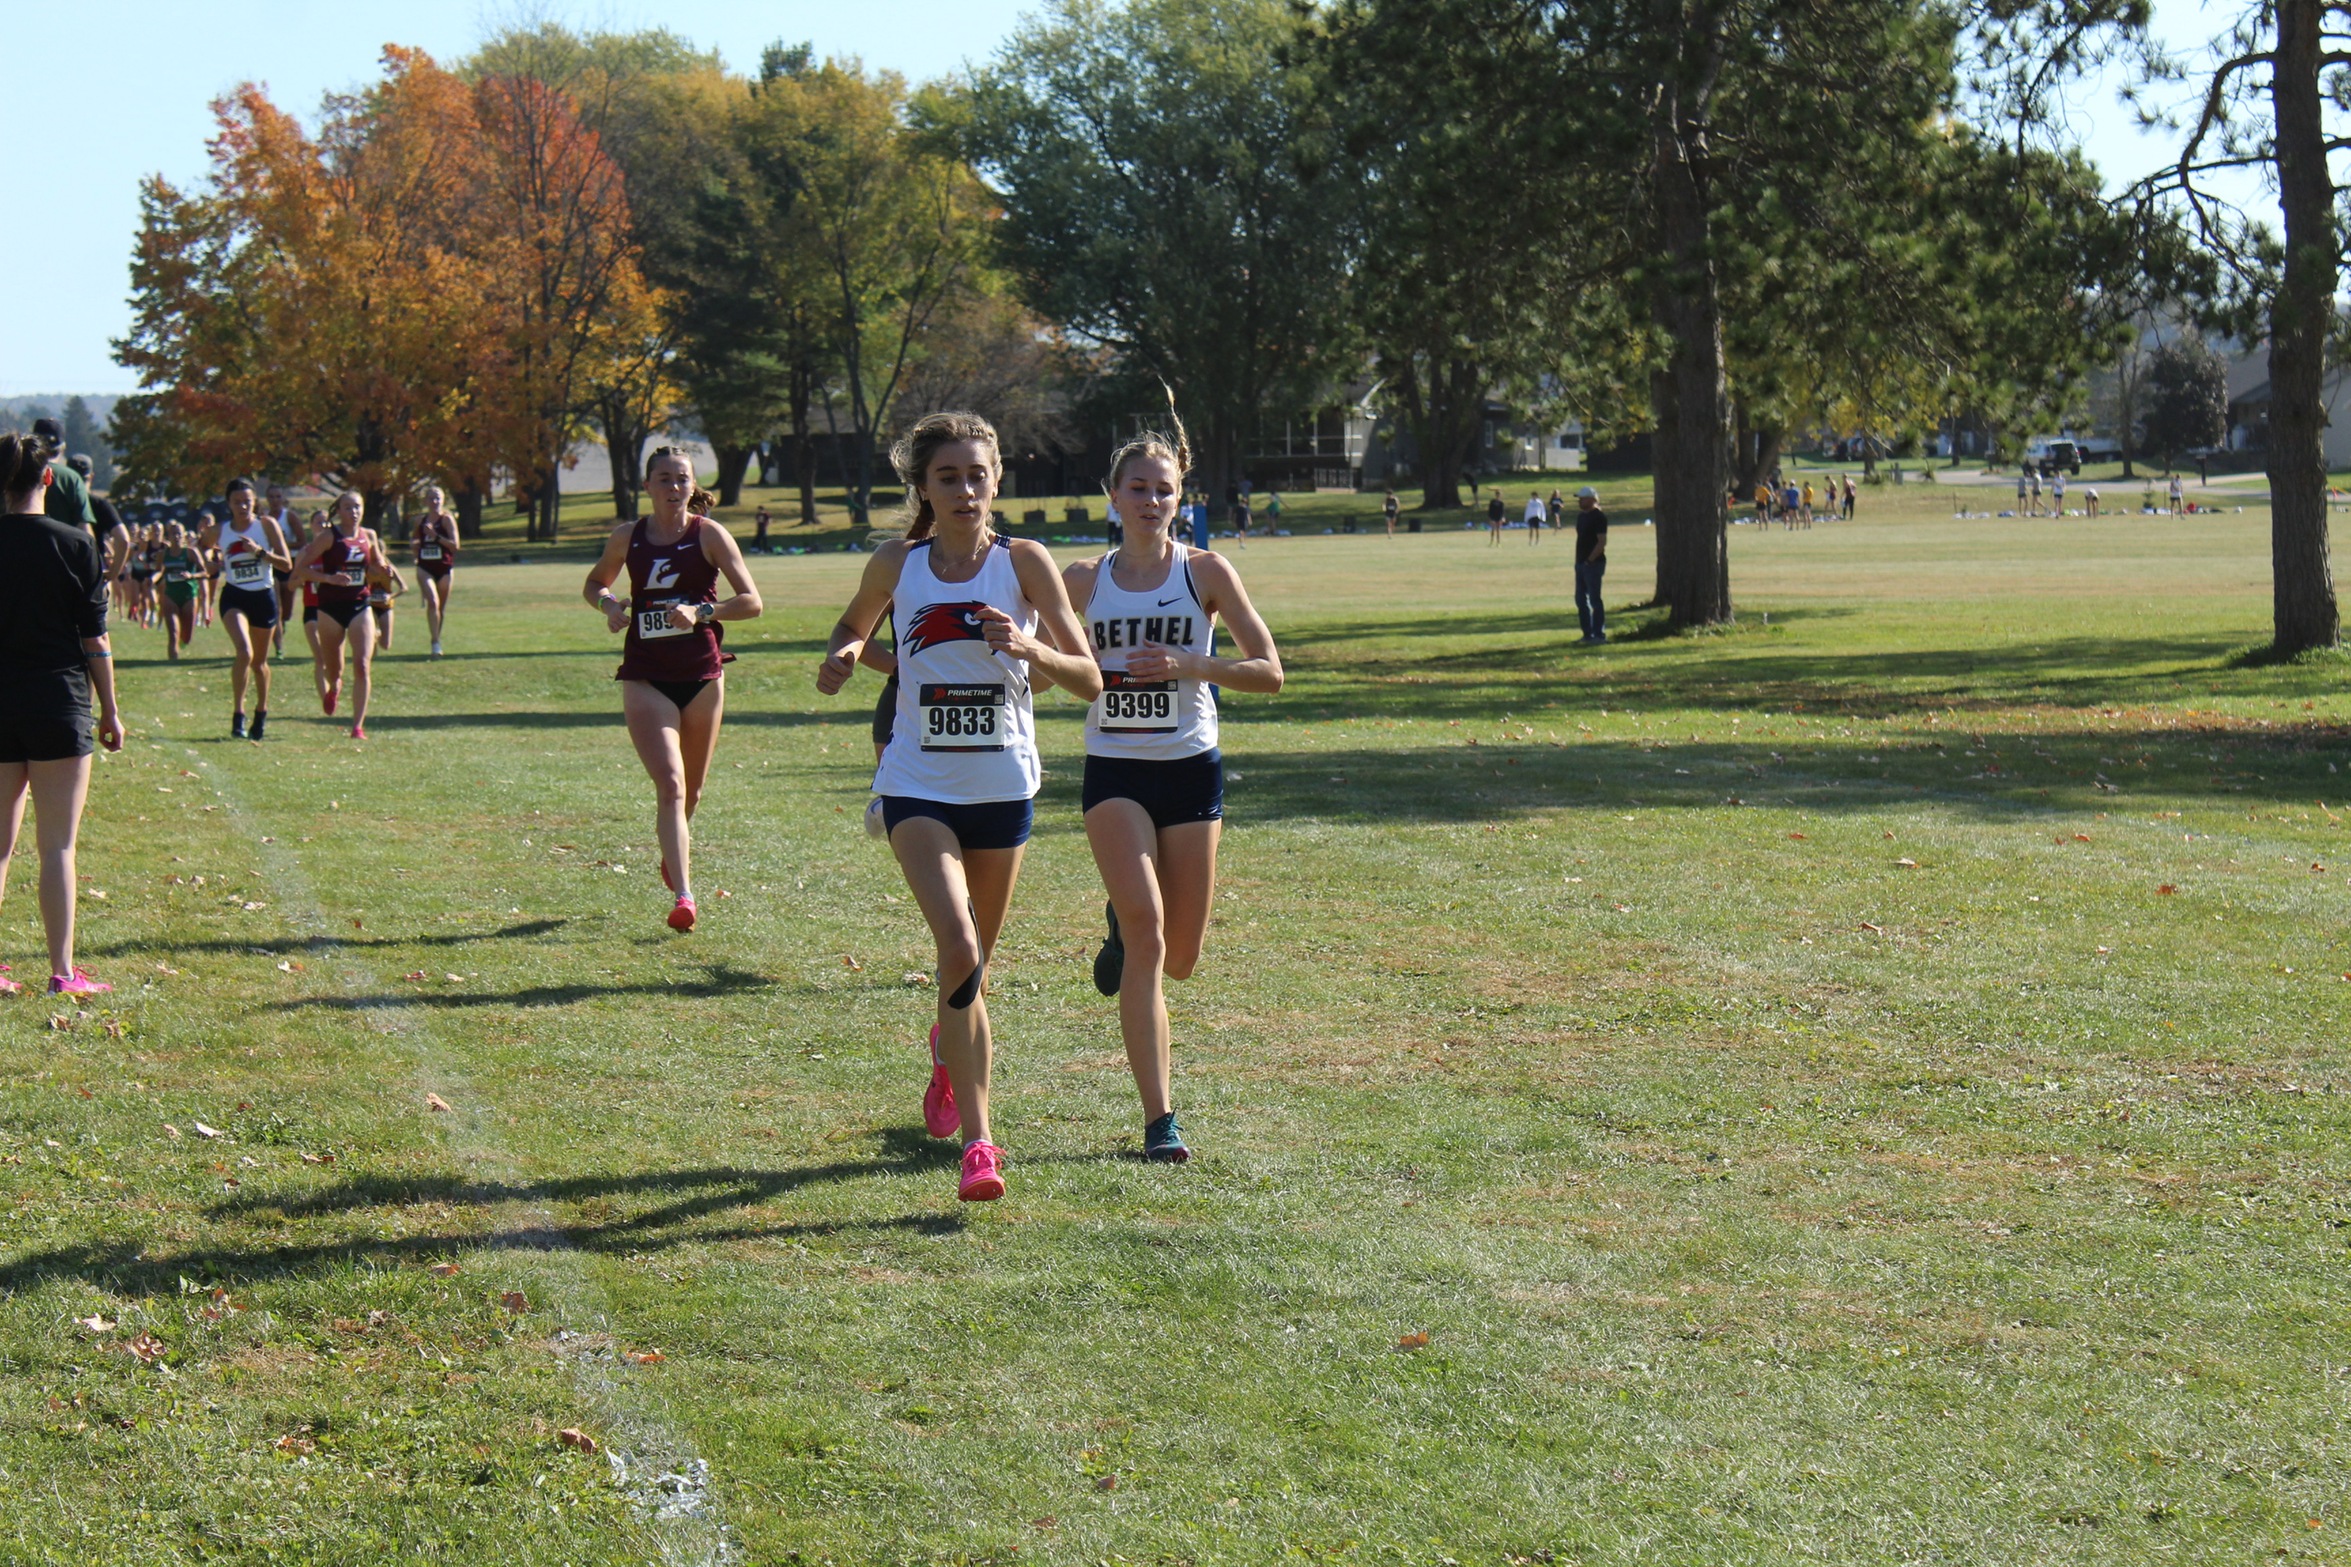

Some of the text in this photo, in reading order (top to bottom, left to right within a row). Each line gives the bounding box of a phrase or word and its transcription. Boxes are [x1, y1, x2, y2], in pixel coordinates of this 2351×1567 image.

[643, 611, 675, 632] 989
[1094, 616, 1195, 650] BETHEL
[947, 689, 993, 697] PRIMETIME
[1105, 692, 1170, 719] 9399
[929, 706, 995, 736] 9833
